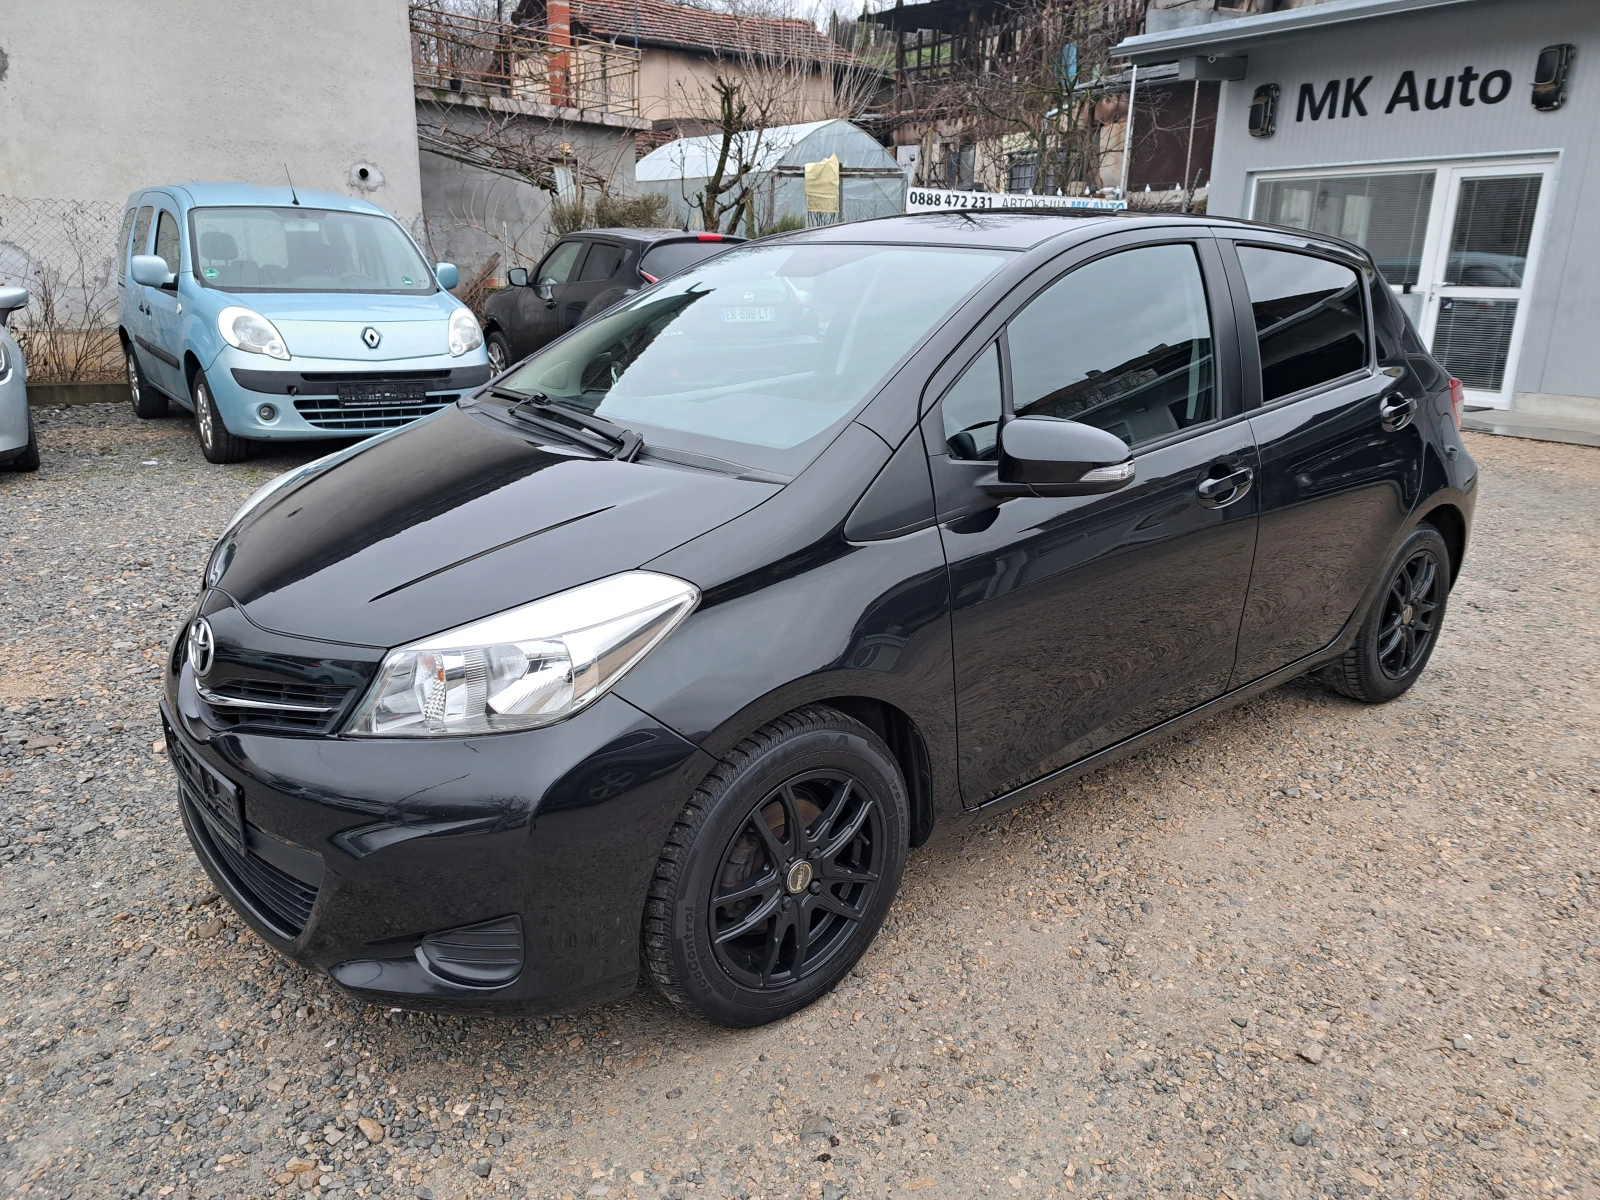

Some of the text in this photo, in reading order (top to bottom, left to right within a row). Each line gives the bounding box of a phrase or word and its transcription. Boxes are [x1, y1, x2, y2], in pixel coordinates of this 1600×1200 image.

[1296, 66, 1512, 122] MK Auto
[910, 191, 992, 208] 0888 472 231
[684, 906, 714, 996] EcoControl
